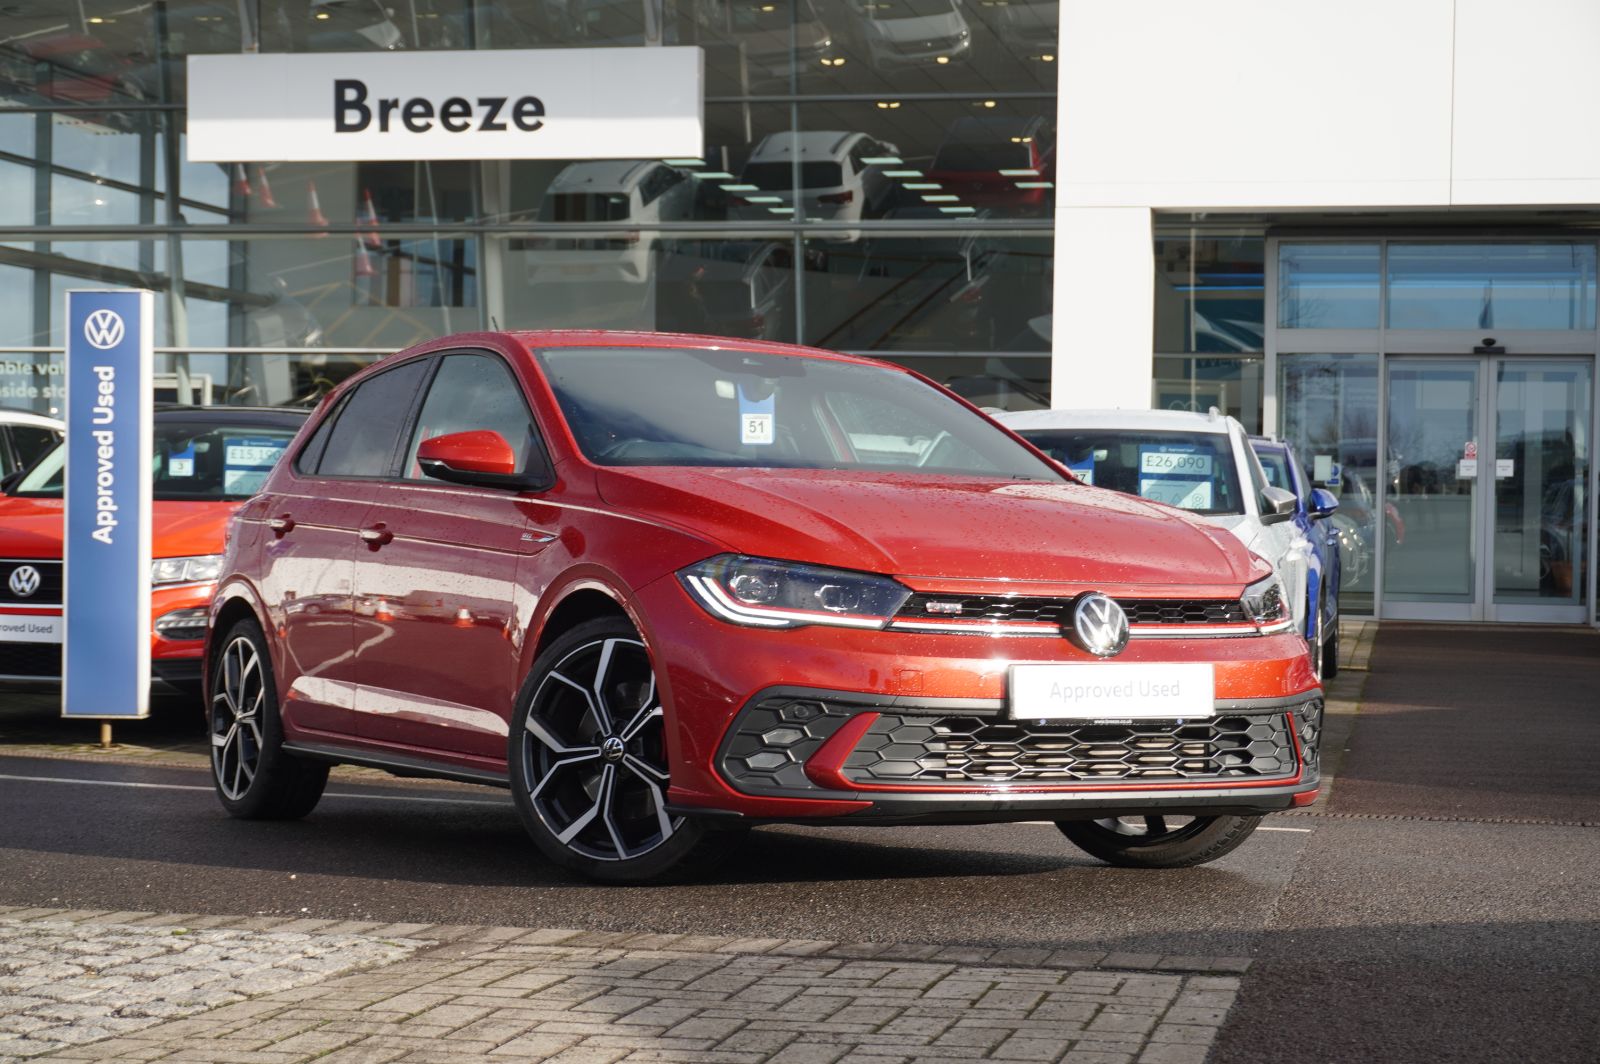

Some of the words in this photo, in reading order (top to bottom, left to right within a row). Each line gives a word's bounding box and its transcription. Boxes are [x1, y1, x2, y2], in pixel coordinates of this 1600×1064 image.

[334, 79, 545, 133] Breeze
[92, 366, 115, 424] Used
[749, 420, 764, 433] 51
[1146, 455, 1205, 469] £26,090
[92, 431, 118, 544] Approved
[0, 623, 26, 633] oved
[28, 624, 53, 634] Used
[1049, 681, 1134, 703] Approved
[1139, 680, 1181, 698] Used
